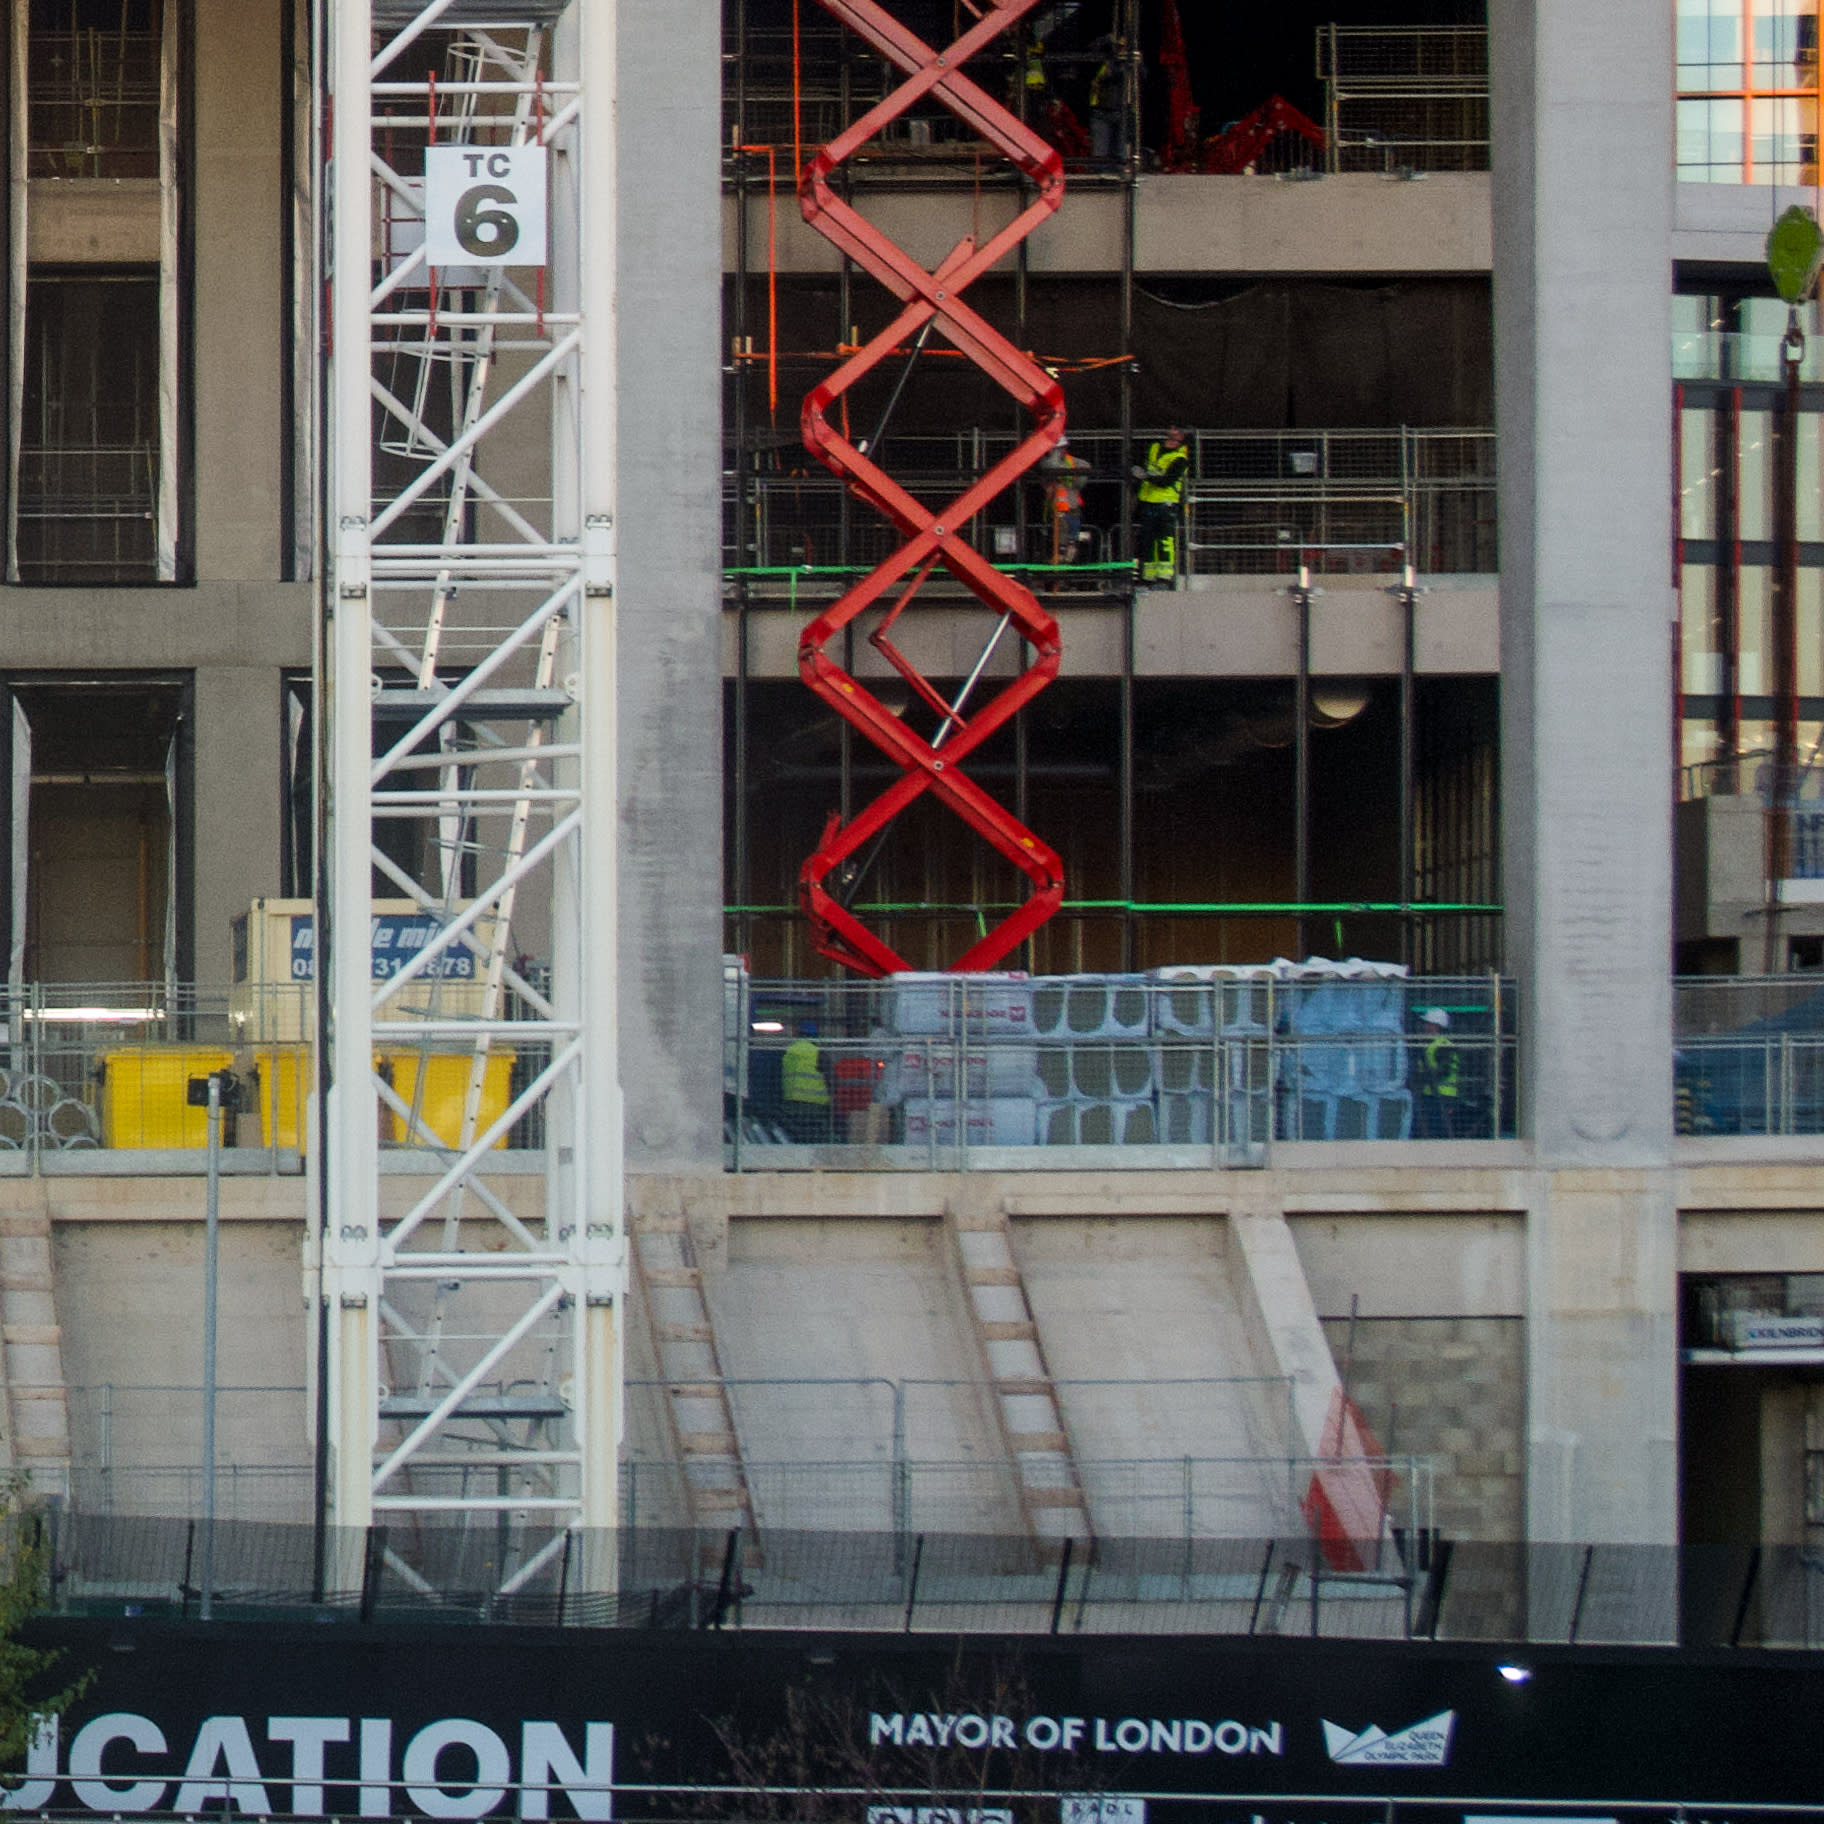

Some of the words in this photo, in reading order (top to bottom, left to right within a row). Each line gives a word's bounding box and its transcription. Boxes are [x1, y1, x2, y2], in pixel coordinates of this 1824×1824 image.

[463, 153, 511, 178] TC
[454, 184, 519, 257] 6
[869, 1712, 1018, 1750] MAYOR
[1025, 1716, 1086, 1751] OF
[1095, 1718, 1283, 1755] LONDON
